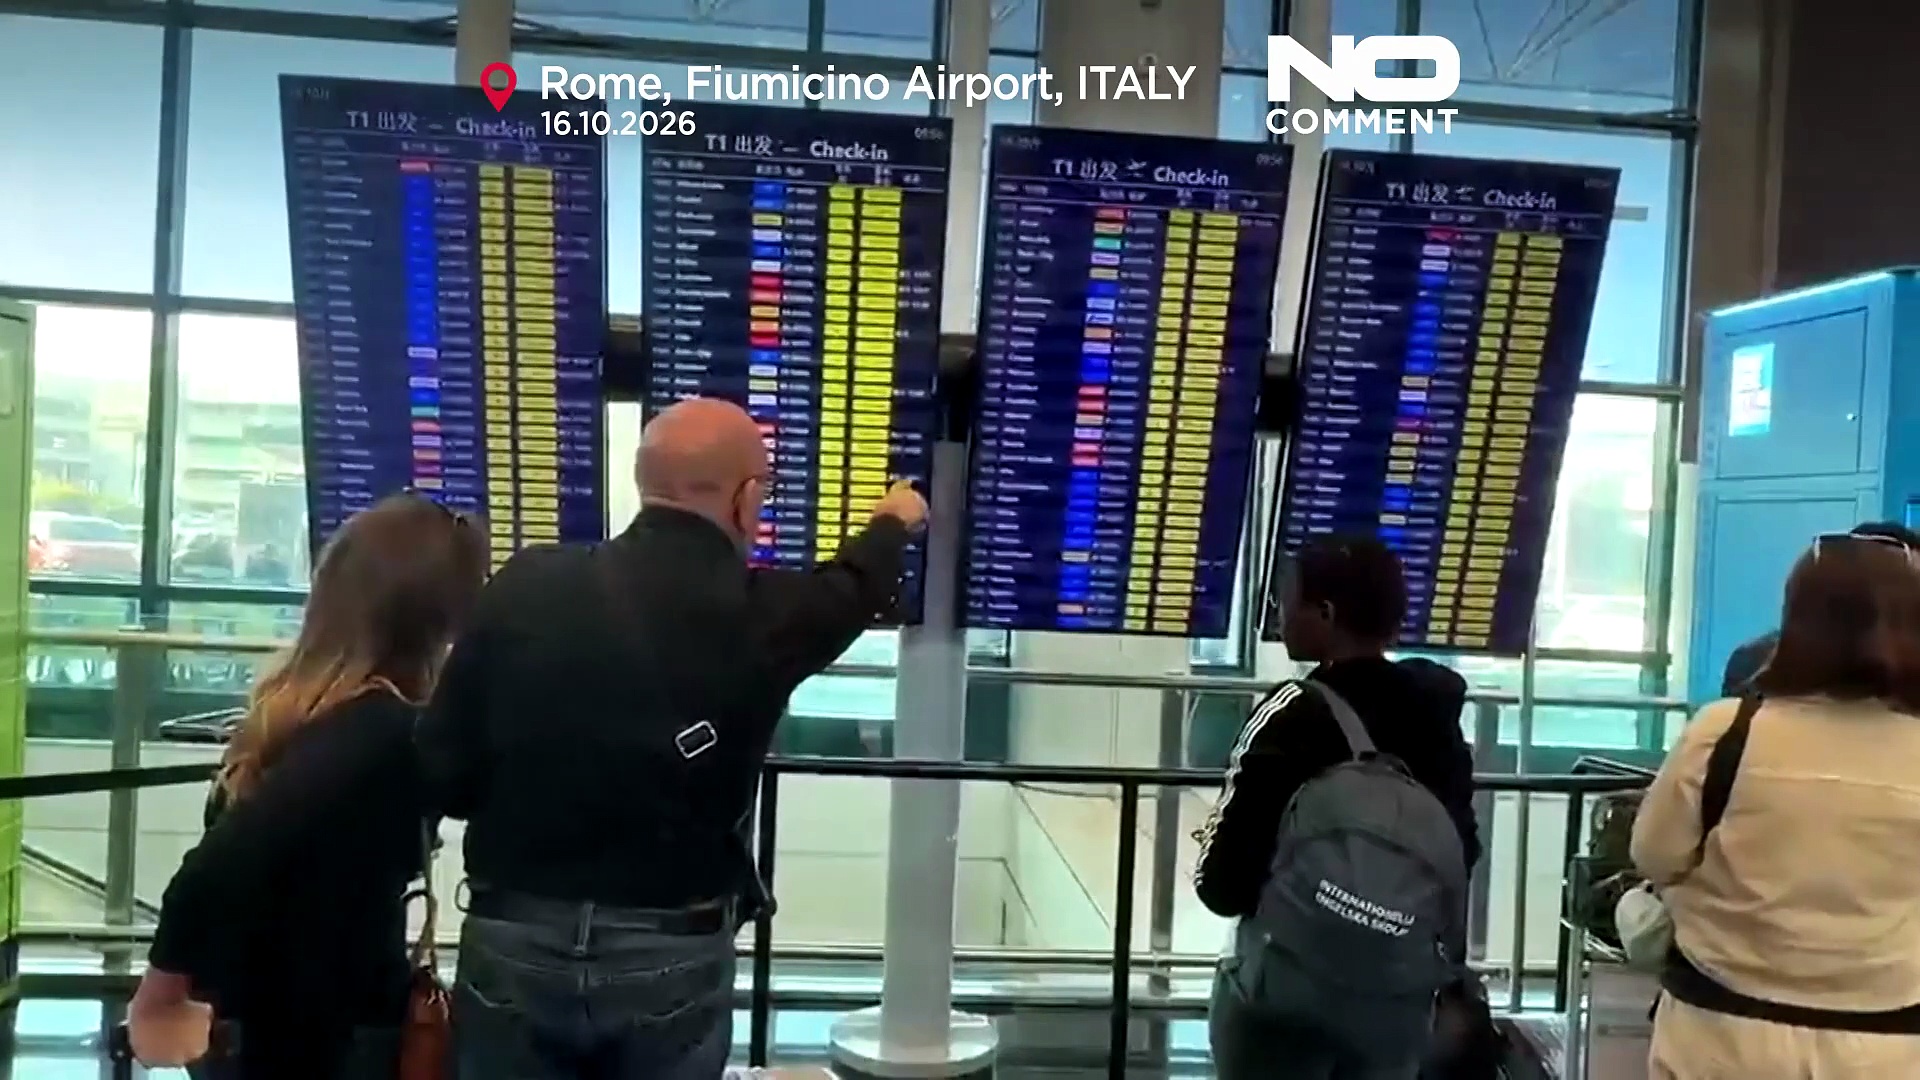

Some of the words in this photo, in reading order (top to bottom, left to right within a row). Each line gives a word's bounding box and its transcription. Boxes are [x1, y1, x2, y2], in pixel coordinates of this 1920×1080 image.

[346, 111, 369, 128] T1
[455, 117, 537, 139] Check-in
[704, 134, 726, 151] T1
[809, 141, 889, 161] Check-in
[1051, 159, 1073, 175] T1
[1153, 166, 1230, 186] Check-in
[1386, 183, 1406, 199] T1
[1483, 189, 1557, 210] Check-in
